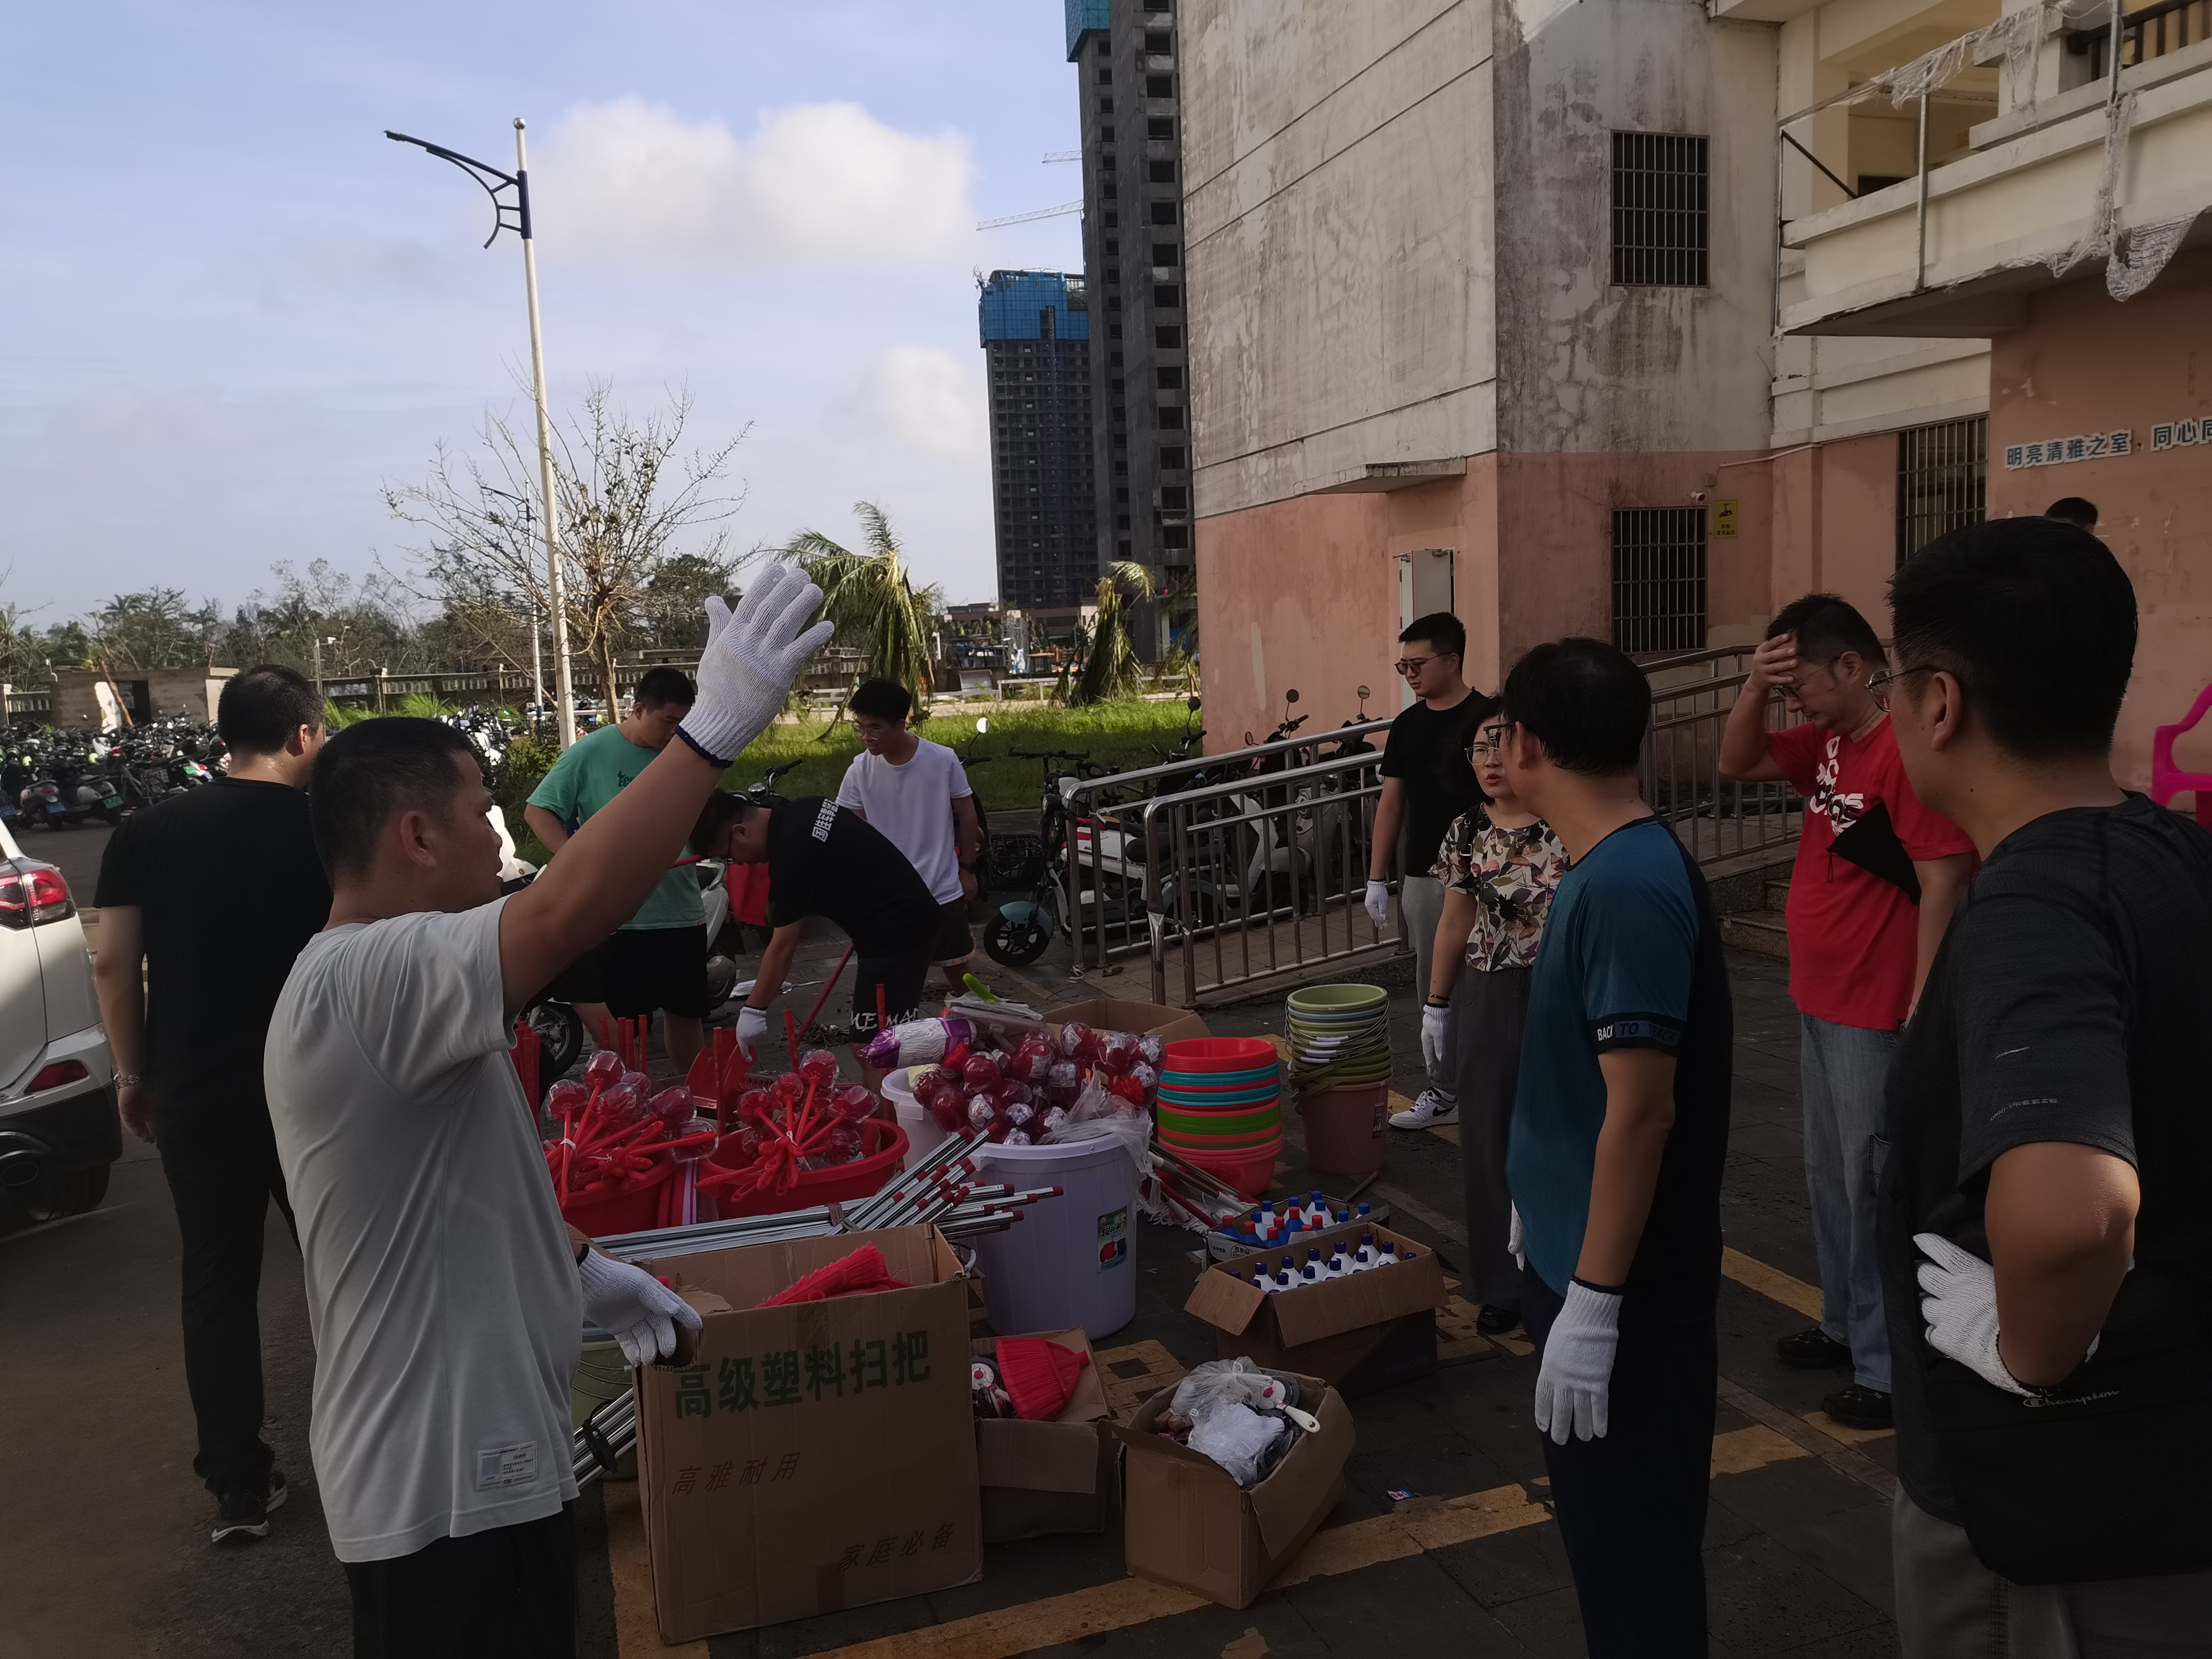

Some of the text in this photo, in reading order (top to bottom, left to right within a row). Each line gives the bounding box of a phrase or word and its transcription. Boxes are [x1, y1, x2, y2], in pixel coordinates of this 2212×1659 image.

[2007, 432, 2128, 466] 明亮清雅之室
[1597, 1024, 1614, 1041] BACK
[1620, 1022, 1640, 1036] TO
[1990, 1098, 2058, 1121] OMNI-FREEZE
[1235, 1246, 1250, 1255] 百岁山
[674, 1329, 931, 1419] 高级塑料扫把
[2022, 1390, 2120, 1407] Champion
[672, 1451, 801, 1496] 高雅耐用
[838, 1521, 956, 1572] 家庭必备
